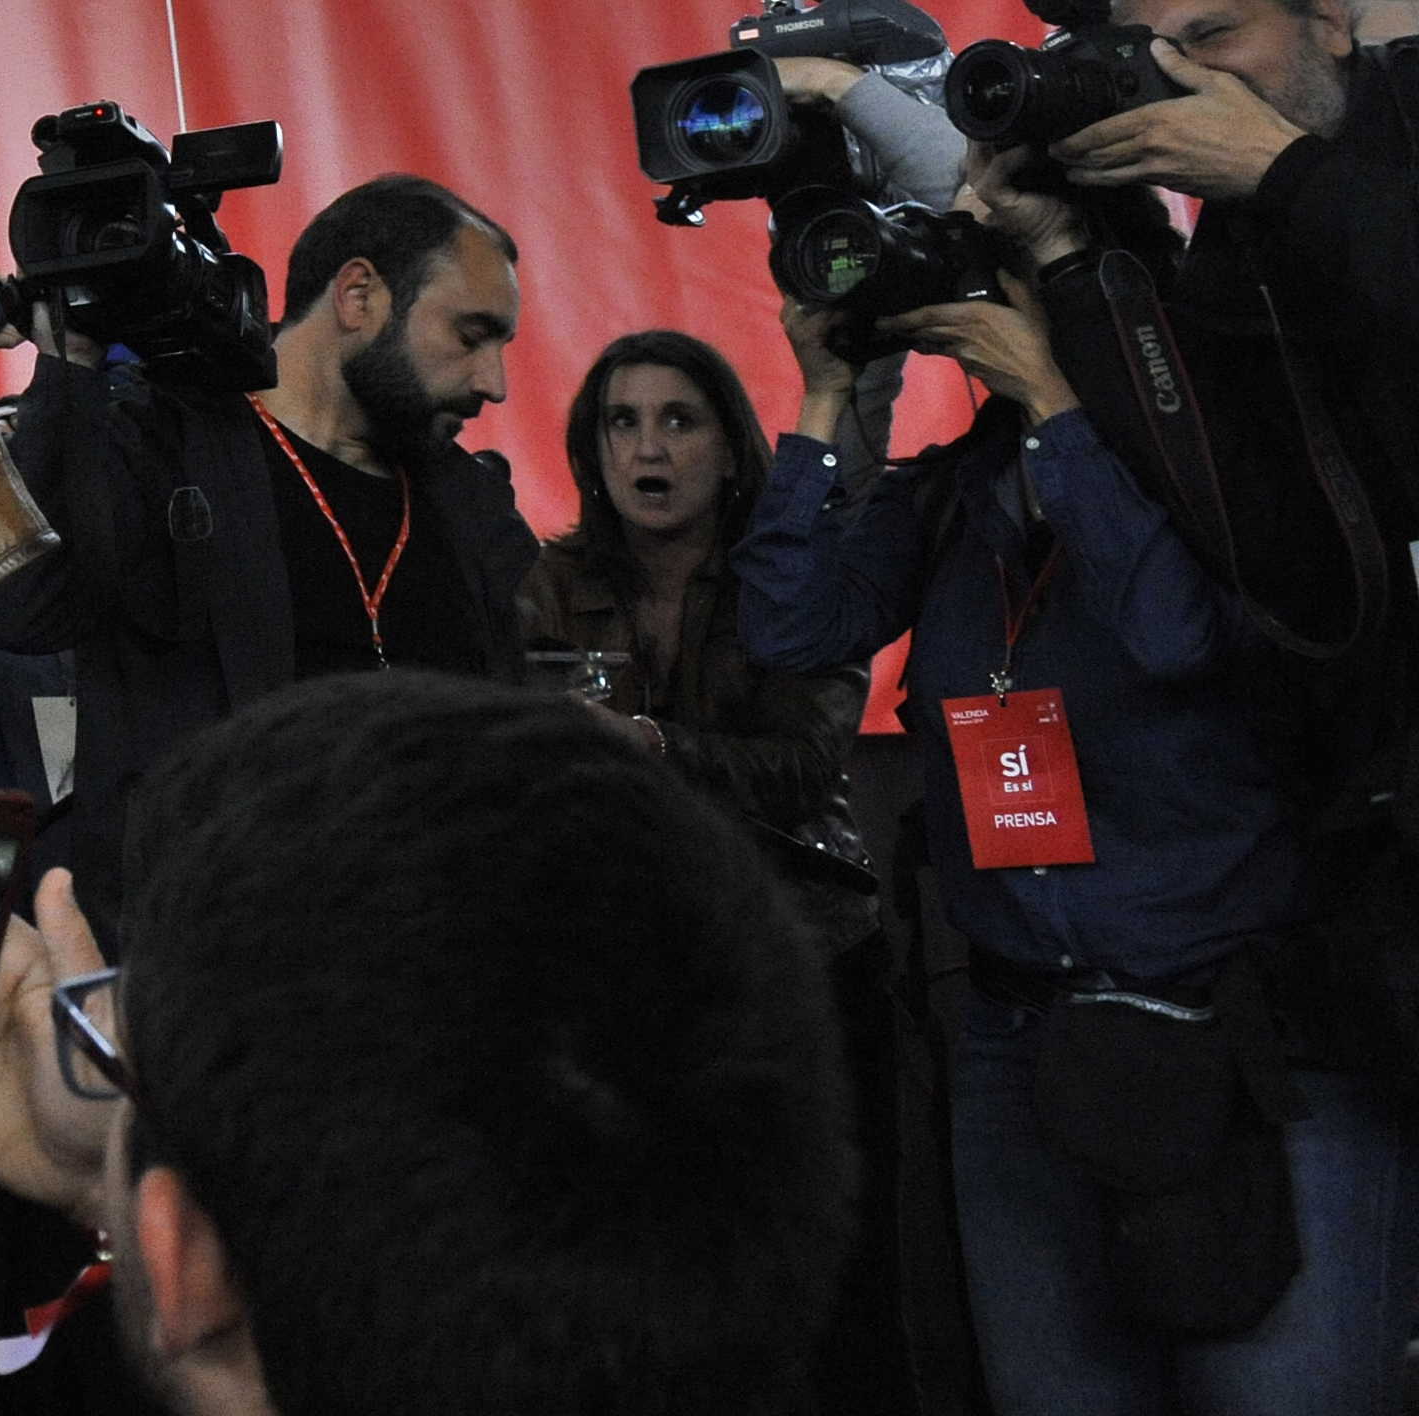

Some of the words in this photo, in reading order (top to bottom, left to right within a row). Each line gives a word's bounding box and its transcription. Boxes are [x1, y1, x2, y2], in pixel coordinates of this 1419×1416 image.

[775, 18, 825, 33] THOMSON
[1137, 326, 1181, 413] Canon
[1000, 744, 1030, 777] SÍ
[1004, 781, 1020, 793] Es
[1022, 780, 1033, 792] sí
[994, 811, 1057, 829] PRENSA
